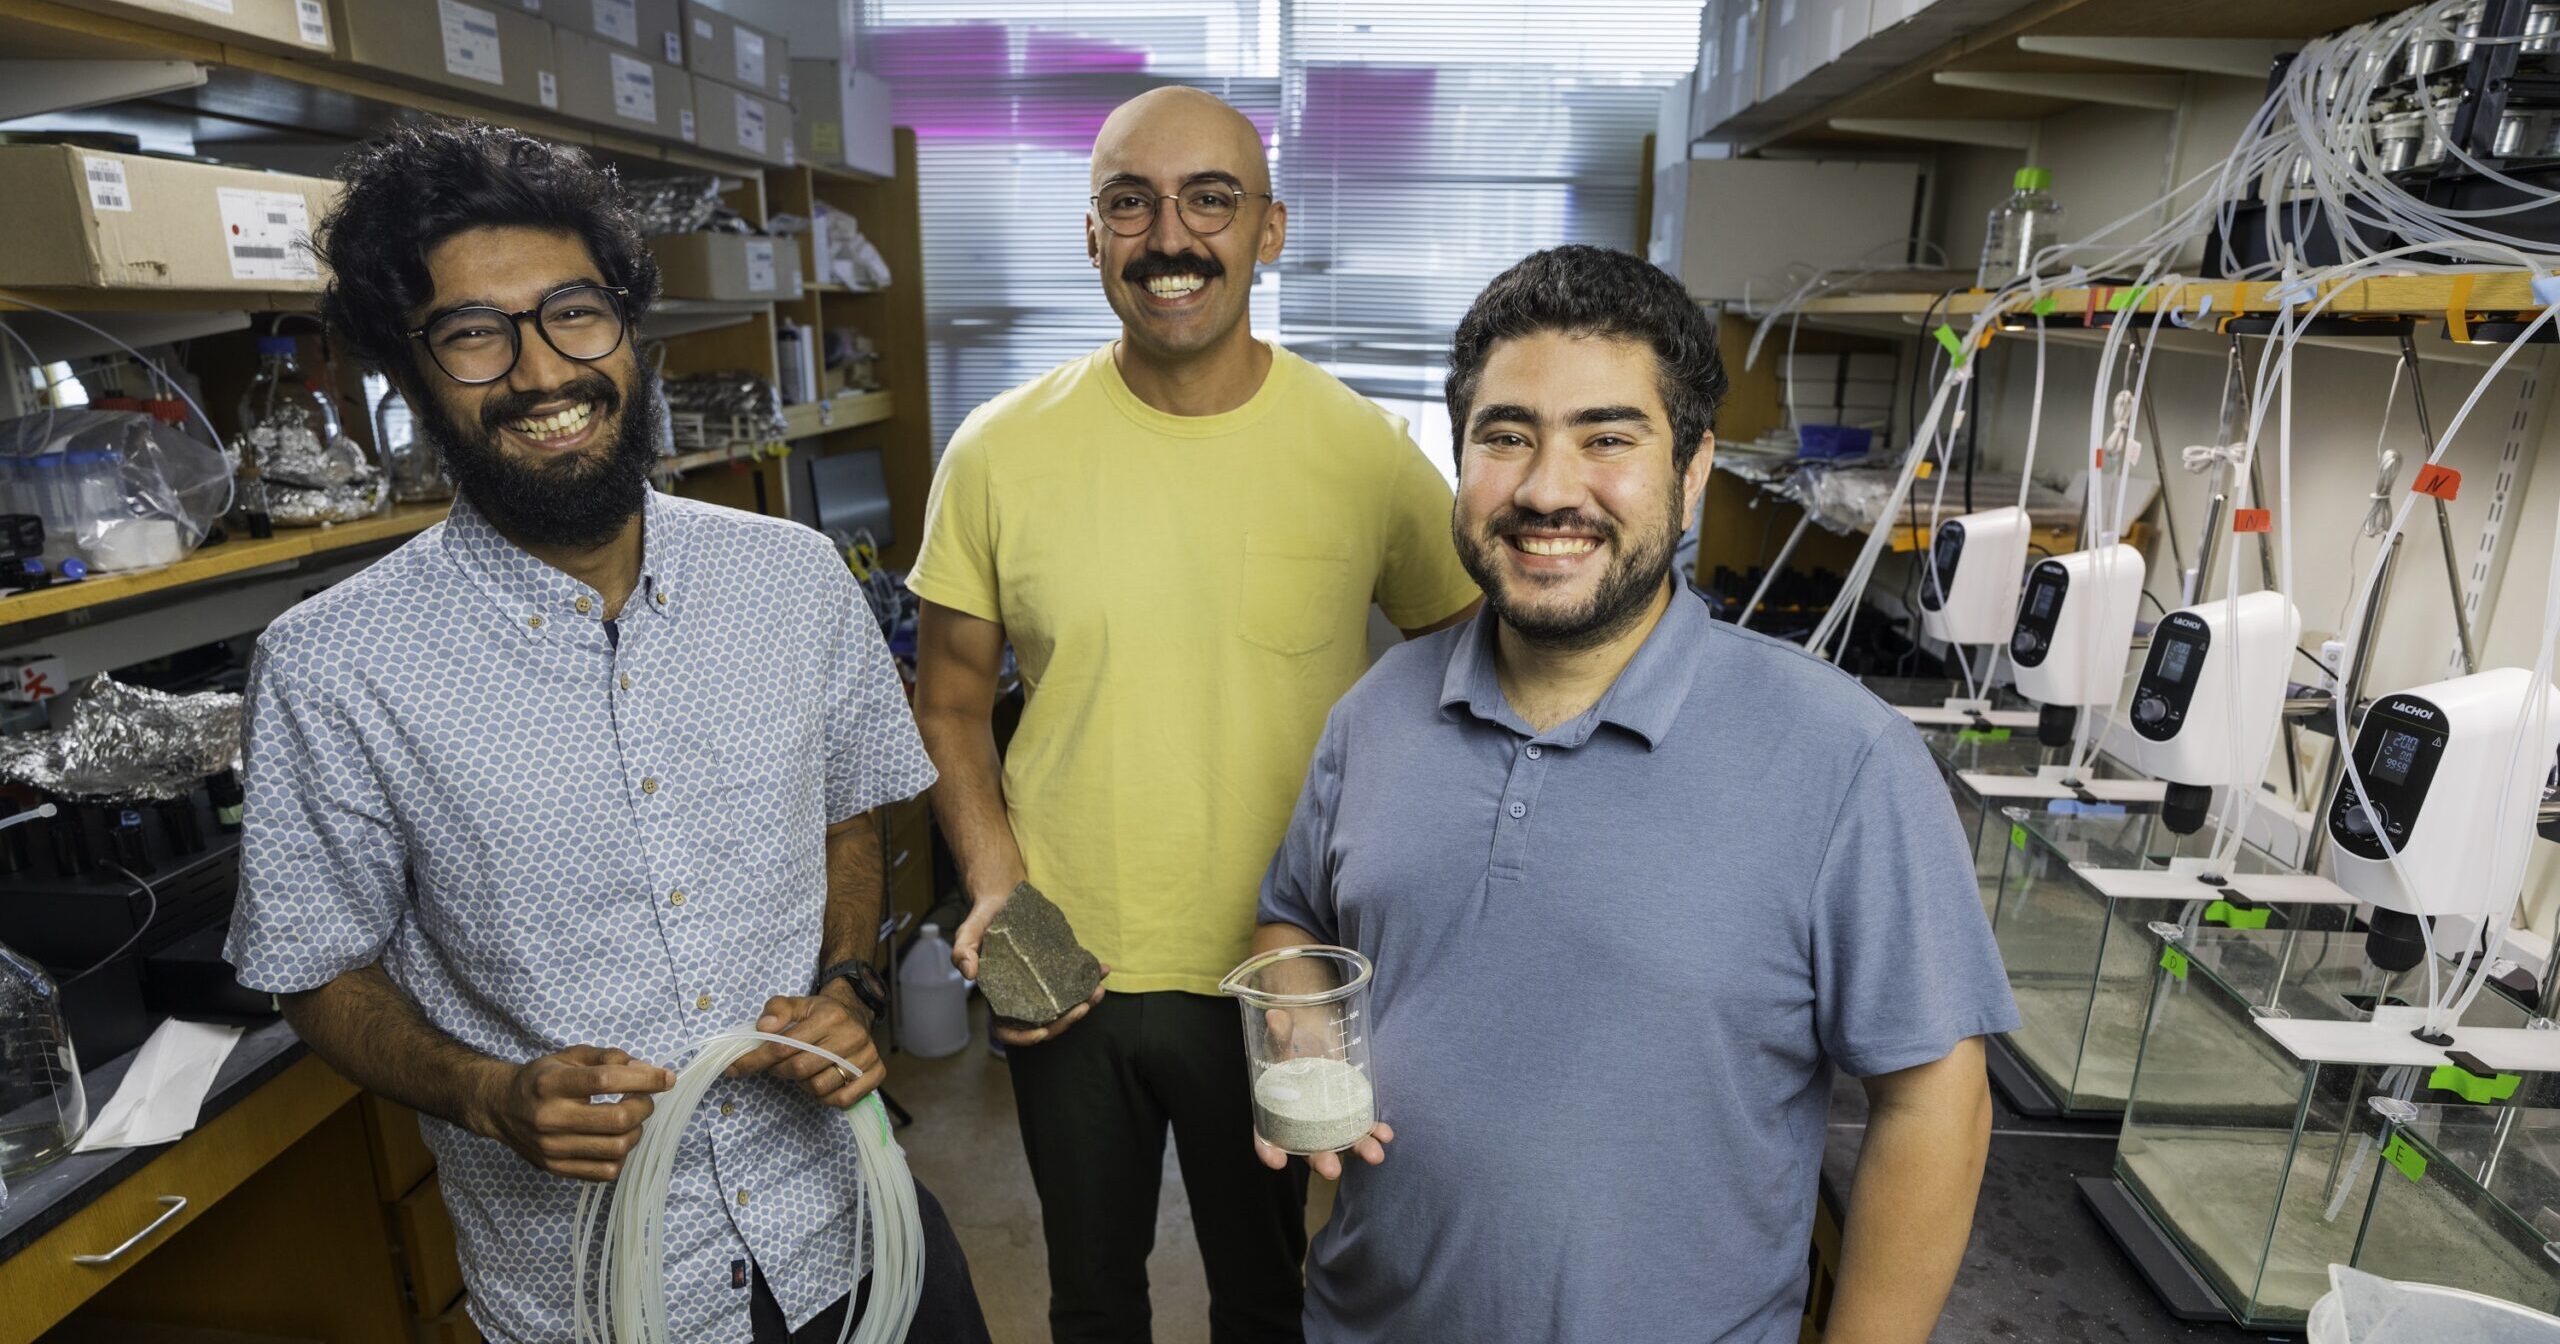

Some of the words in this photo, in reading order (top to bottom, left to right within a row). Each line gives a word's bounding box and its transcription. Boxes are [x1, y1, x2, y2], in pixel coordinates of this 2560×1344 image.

[2425, 474, 2450, 493] N
[2245, 514, 2259, 528] N
[2392, 701, 2434, 720] LACHOI
[2393, 732, 2418, 751] 200
[2395, 1144, 2405, 1165] E
